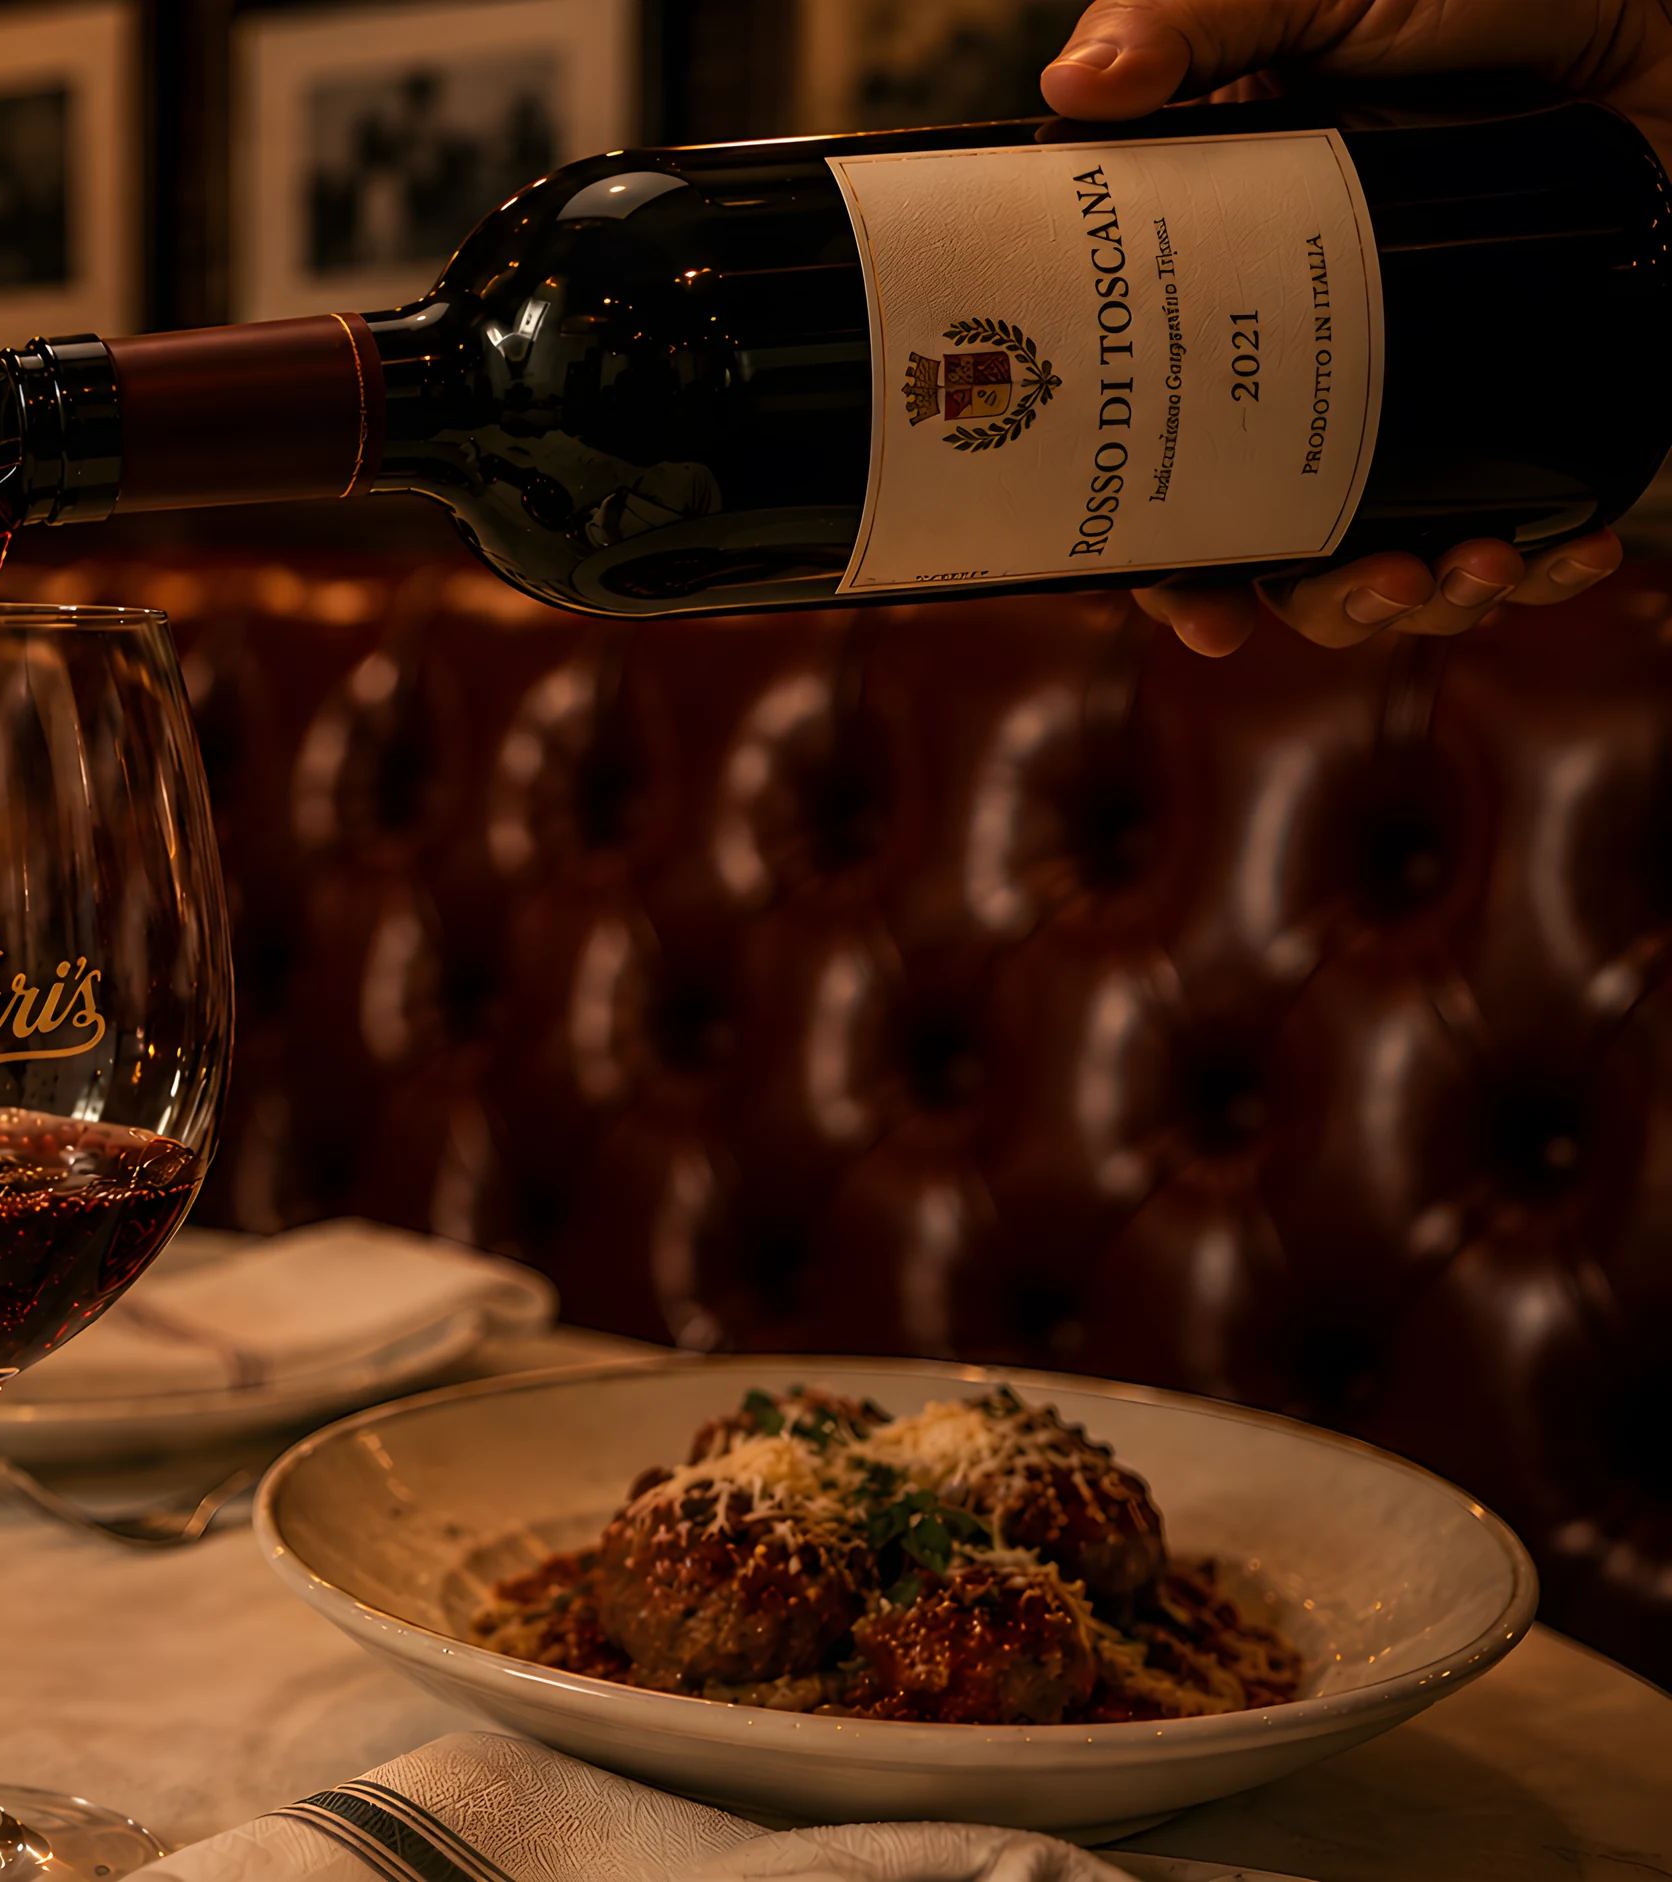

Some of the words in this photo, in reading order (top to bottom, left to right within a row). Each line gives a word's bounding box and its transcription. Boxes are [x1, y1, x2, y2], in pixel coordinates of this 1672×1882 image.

[1072, 164, 1133, 366] TOSCANA
[1306, 234, 1331, 309] ITALIA
[1229, 309, 1261, 403] 2021
[1314, 316, 1332, 342] IN
[1098, 375, 1134, 430] DI
[1301, 349, 1332, 475] PRODOTTO
[1068, 441, 1130, 558] ROSSO
